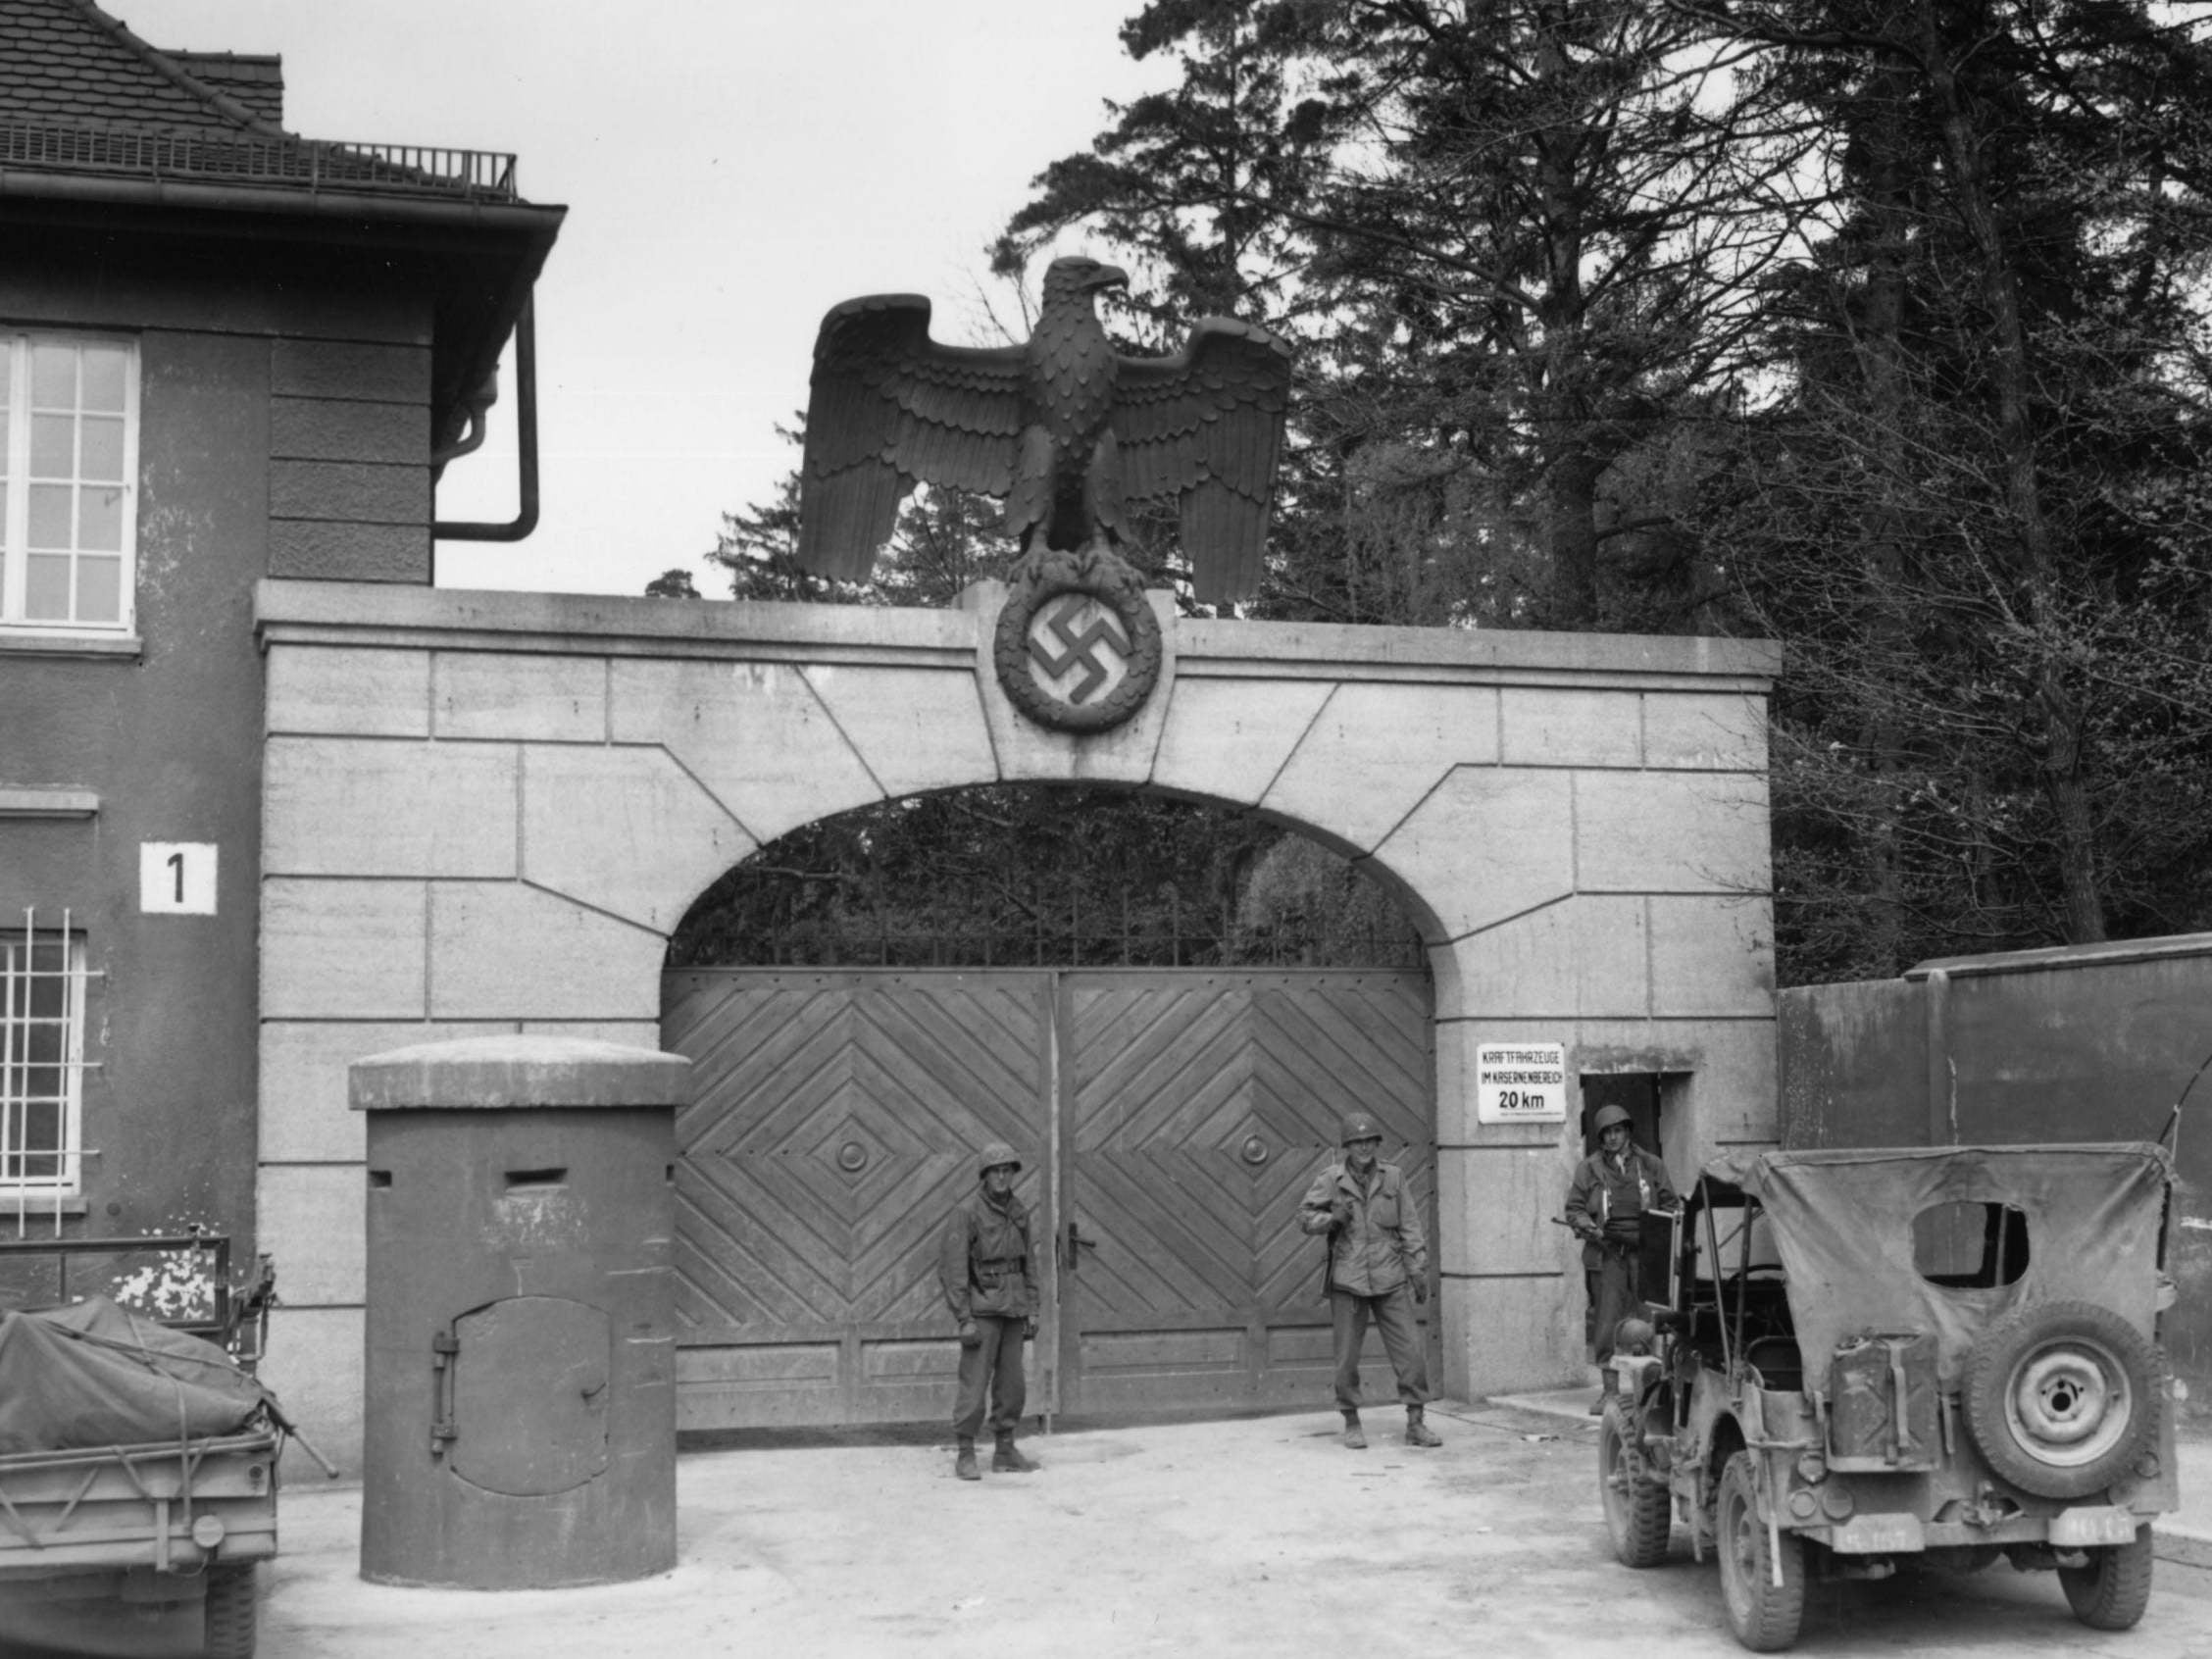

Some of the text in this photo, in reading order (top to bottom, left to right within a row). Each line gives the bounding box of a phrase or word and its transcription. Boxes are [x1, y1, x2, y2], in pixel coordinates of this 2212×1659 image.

[167, 852, 184, 903] 1
[1483, 1051, 1559, 1064] KRAFTFAHRZEUGE
[1482, 1072, 1562, 1084] IM KASERNENBEREICH
[1499, 1091, 1544, 1108] 20 km
